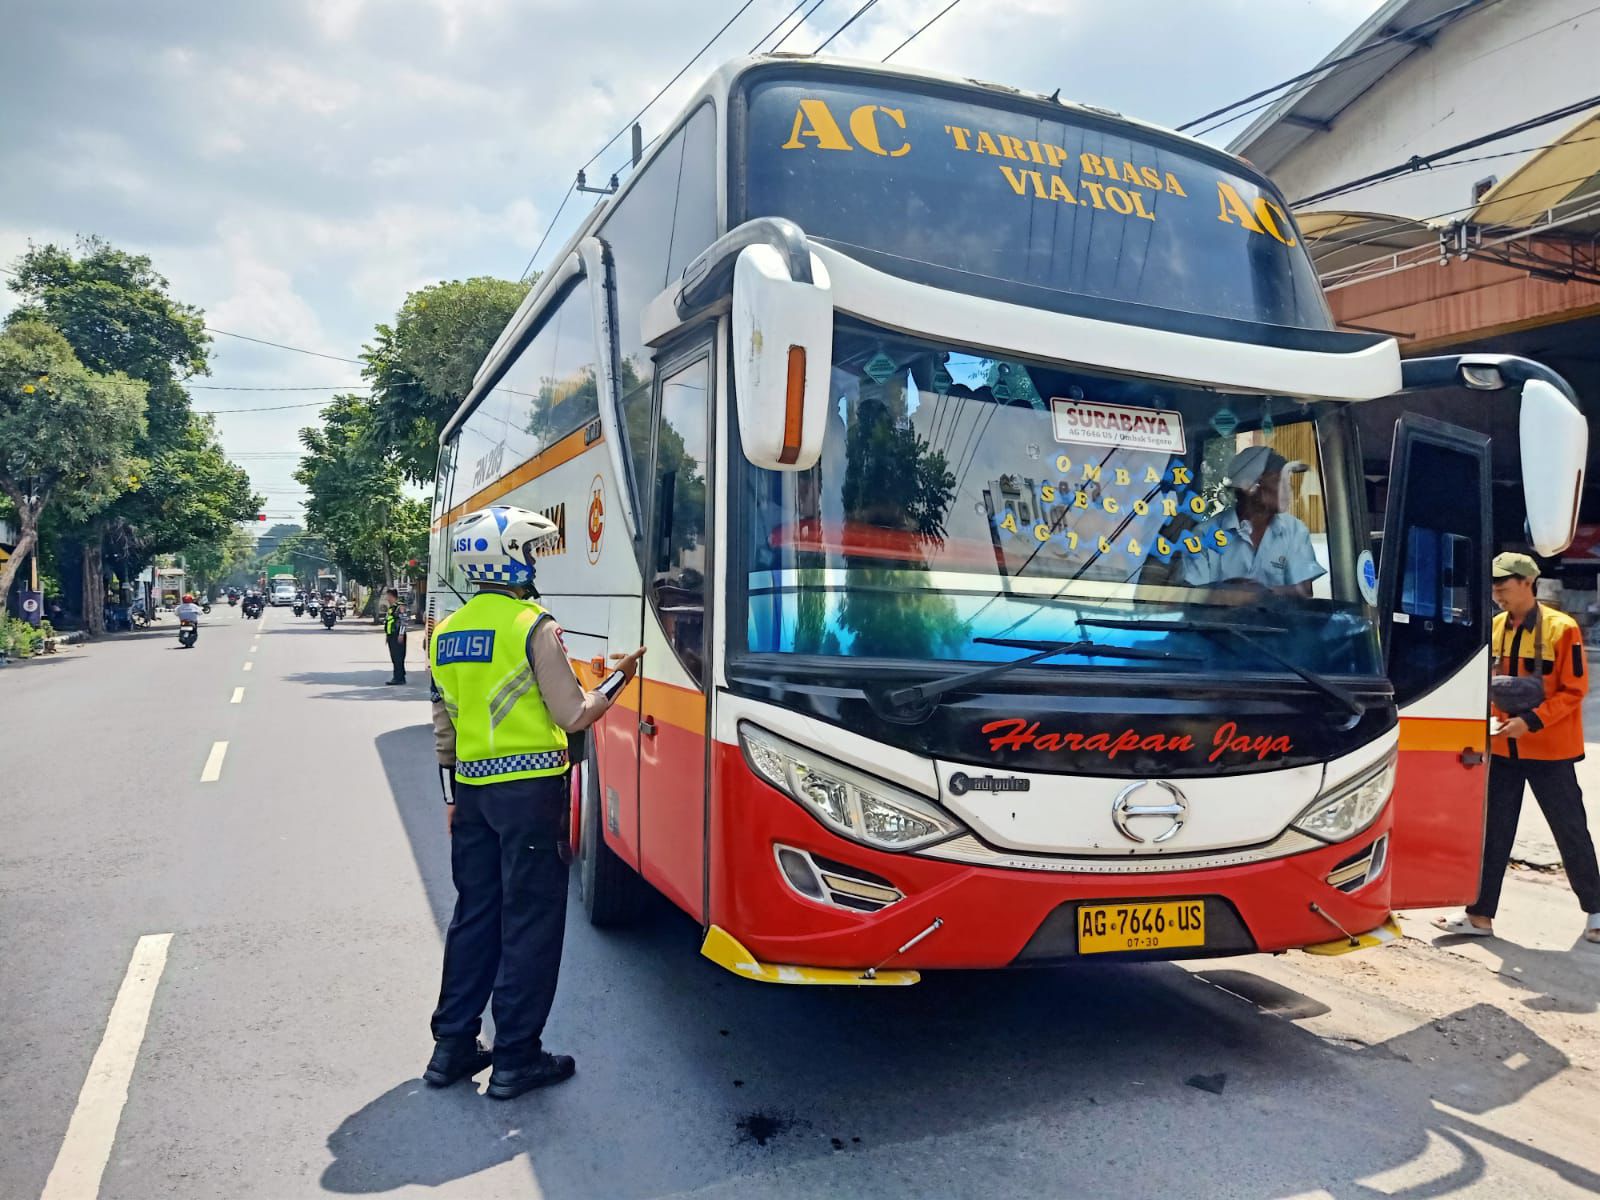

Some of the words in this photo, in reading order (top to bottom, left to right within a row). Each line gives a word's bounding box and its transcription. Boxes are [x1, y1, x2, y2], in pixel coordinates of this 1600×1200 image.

[781, 99, 911, 157] AC
[944, 125, 1069, 168] TARIP
[1079, 152, 1188, 198] BIASA
[999, 165, 1156, 222] VIA.TOL
[1216, 181, 1296, 247] AC
[1066, 408, 1171, 435] SURABAYA
[1119, 433, 1146, 442] Ombak
[1056, 455, 1190, 485] OMBAK
[1041, 485, 1206, 517] SEGORO
[438, 636, 490, 660] POLISI
[981, 718, 1195, 759] Harapan
[1208, 721, 1294, 762] Jaya
[1083, 911, 1106, 937] AG
[1117, 908, 1165, 934] 7646
[1178, 906, 1201, 931] US
